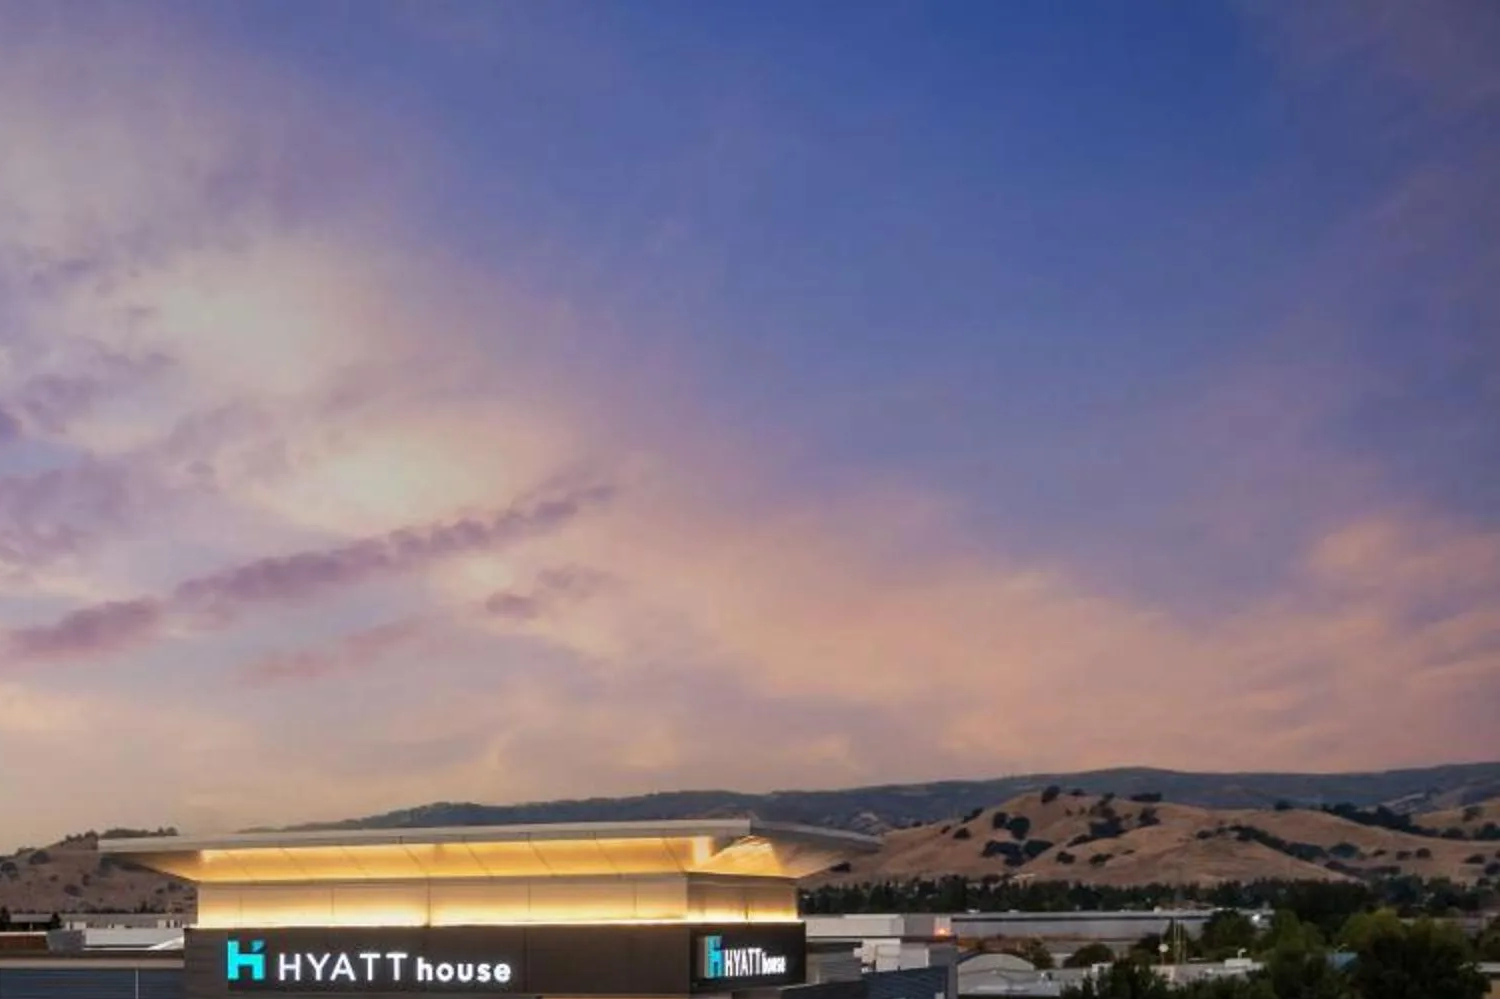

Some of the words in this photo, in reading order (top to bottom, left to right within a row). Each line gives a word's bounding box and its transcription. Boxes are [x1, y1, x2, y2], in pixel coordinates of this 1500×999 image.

[278, 952, 408, 982] HYATT
[416, 957, 512, 982] house
[724, 947, 762, 977] HYATT
